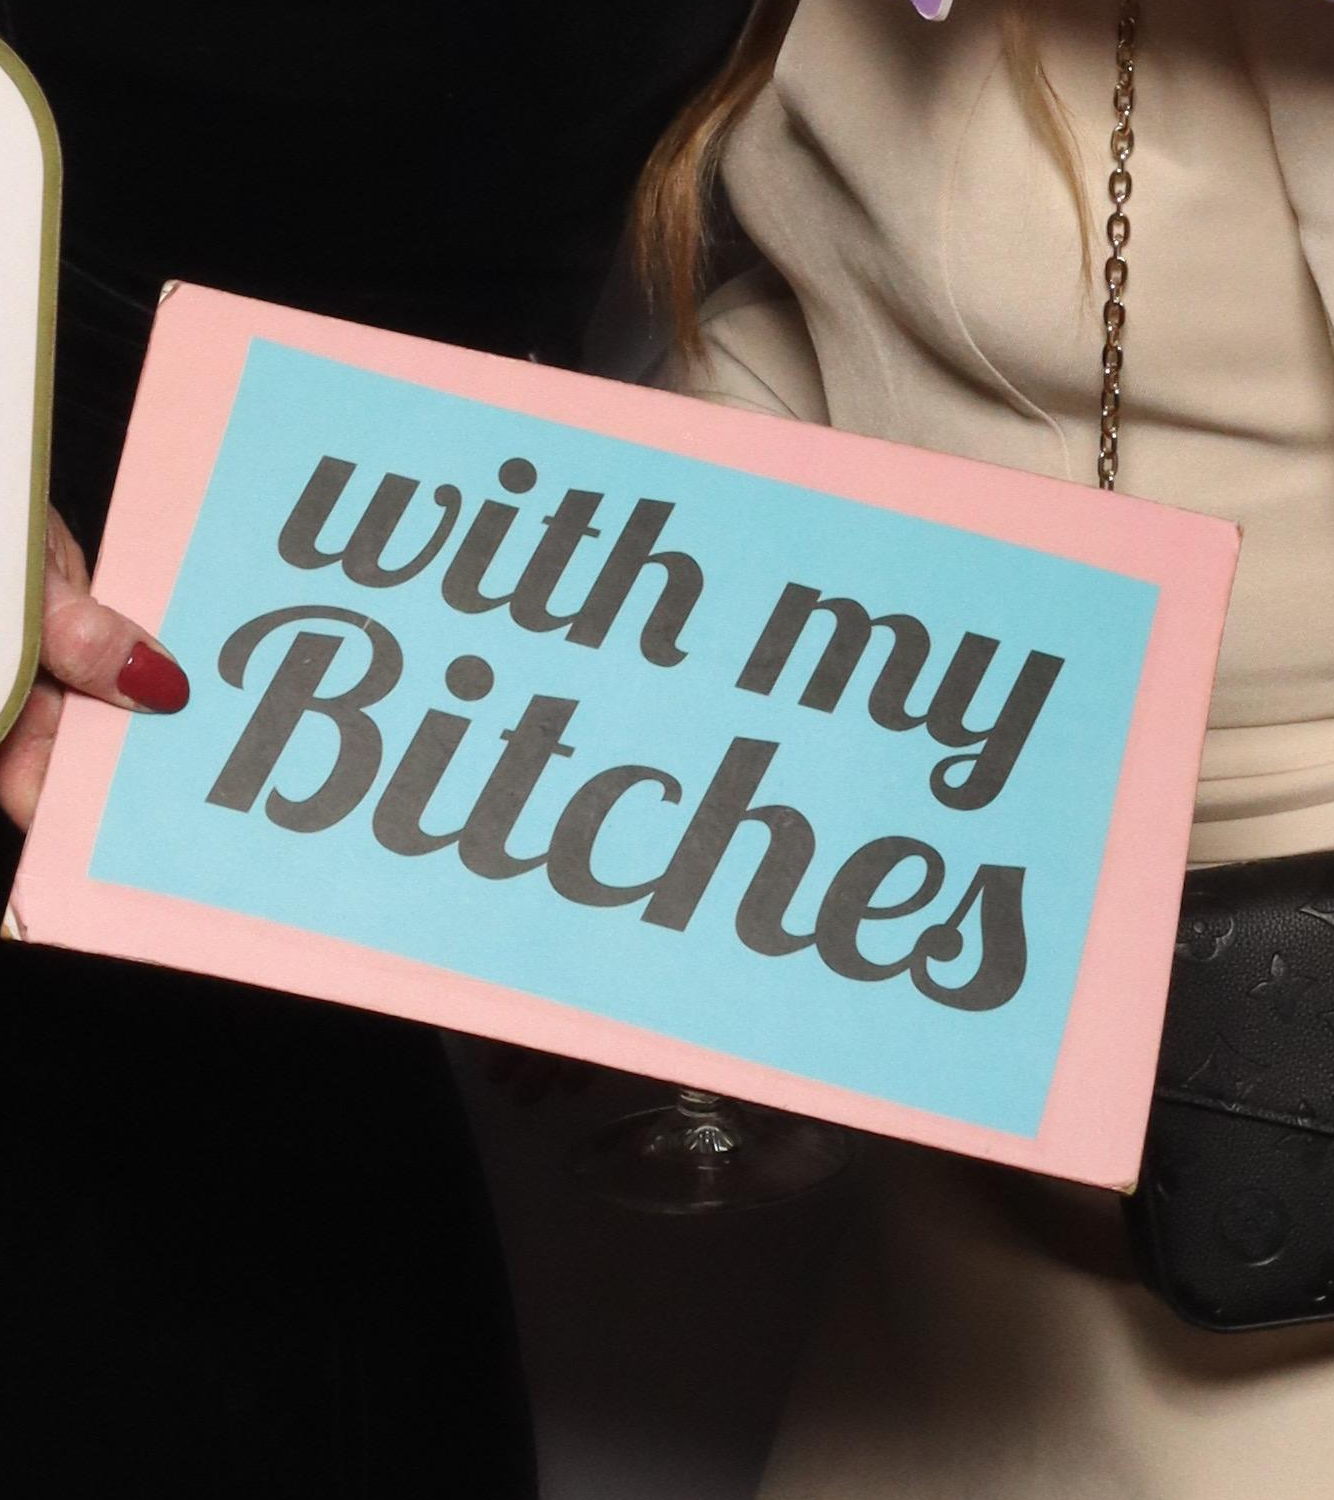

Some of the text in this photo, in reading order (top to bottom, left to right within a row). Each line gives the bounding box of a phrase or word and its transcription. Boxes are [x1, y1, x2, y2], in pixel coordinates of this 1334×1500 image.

[204, 604, 1029, 1013] Bitches
[277, 455, 1066, 813] with my
